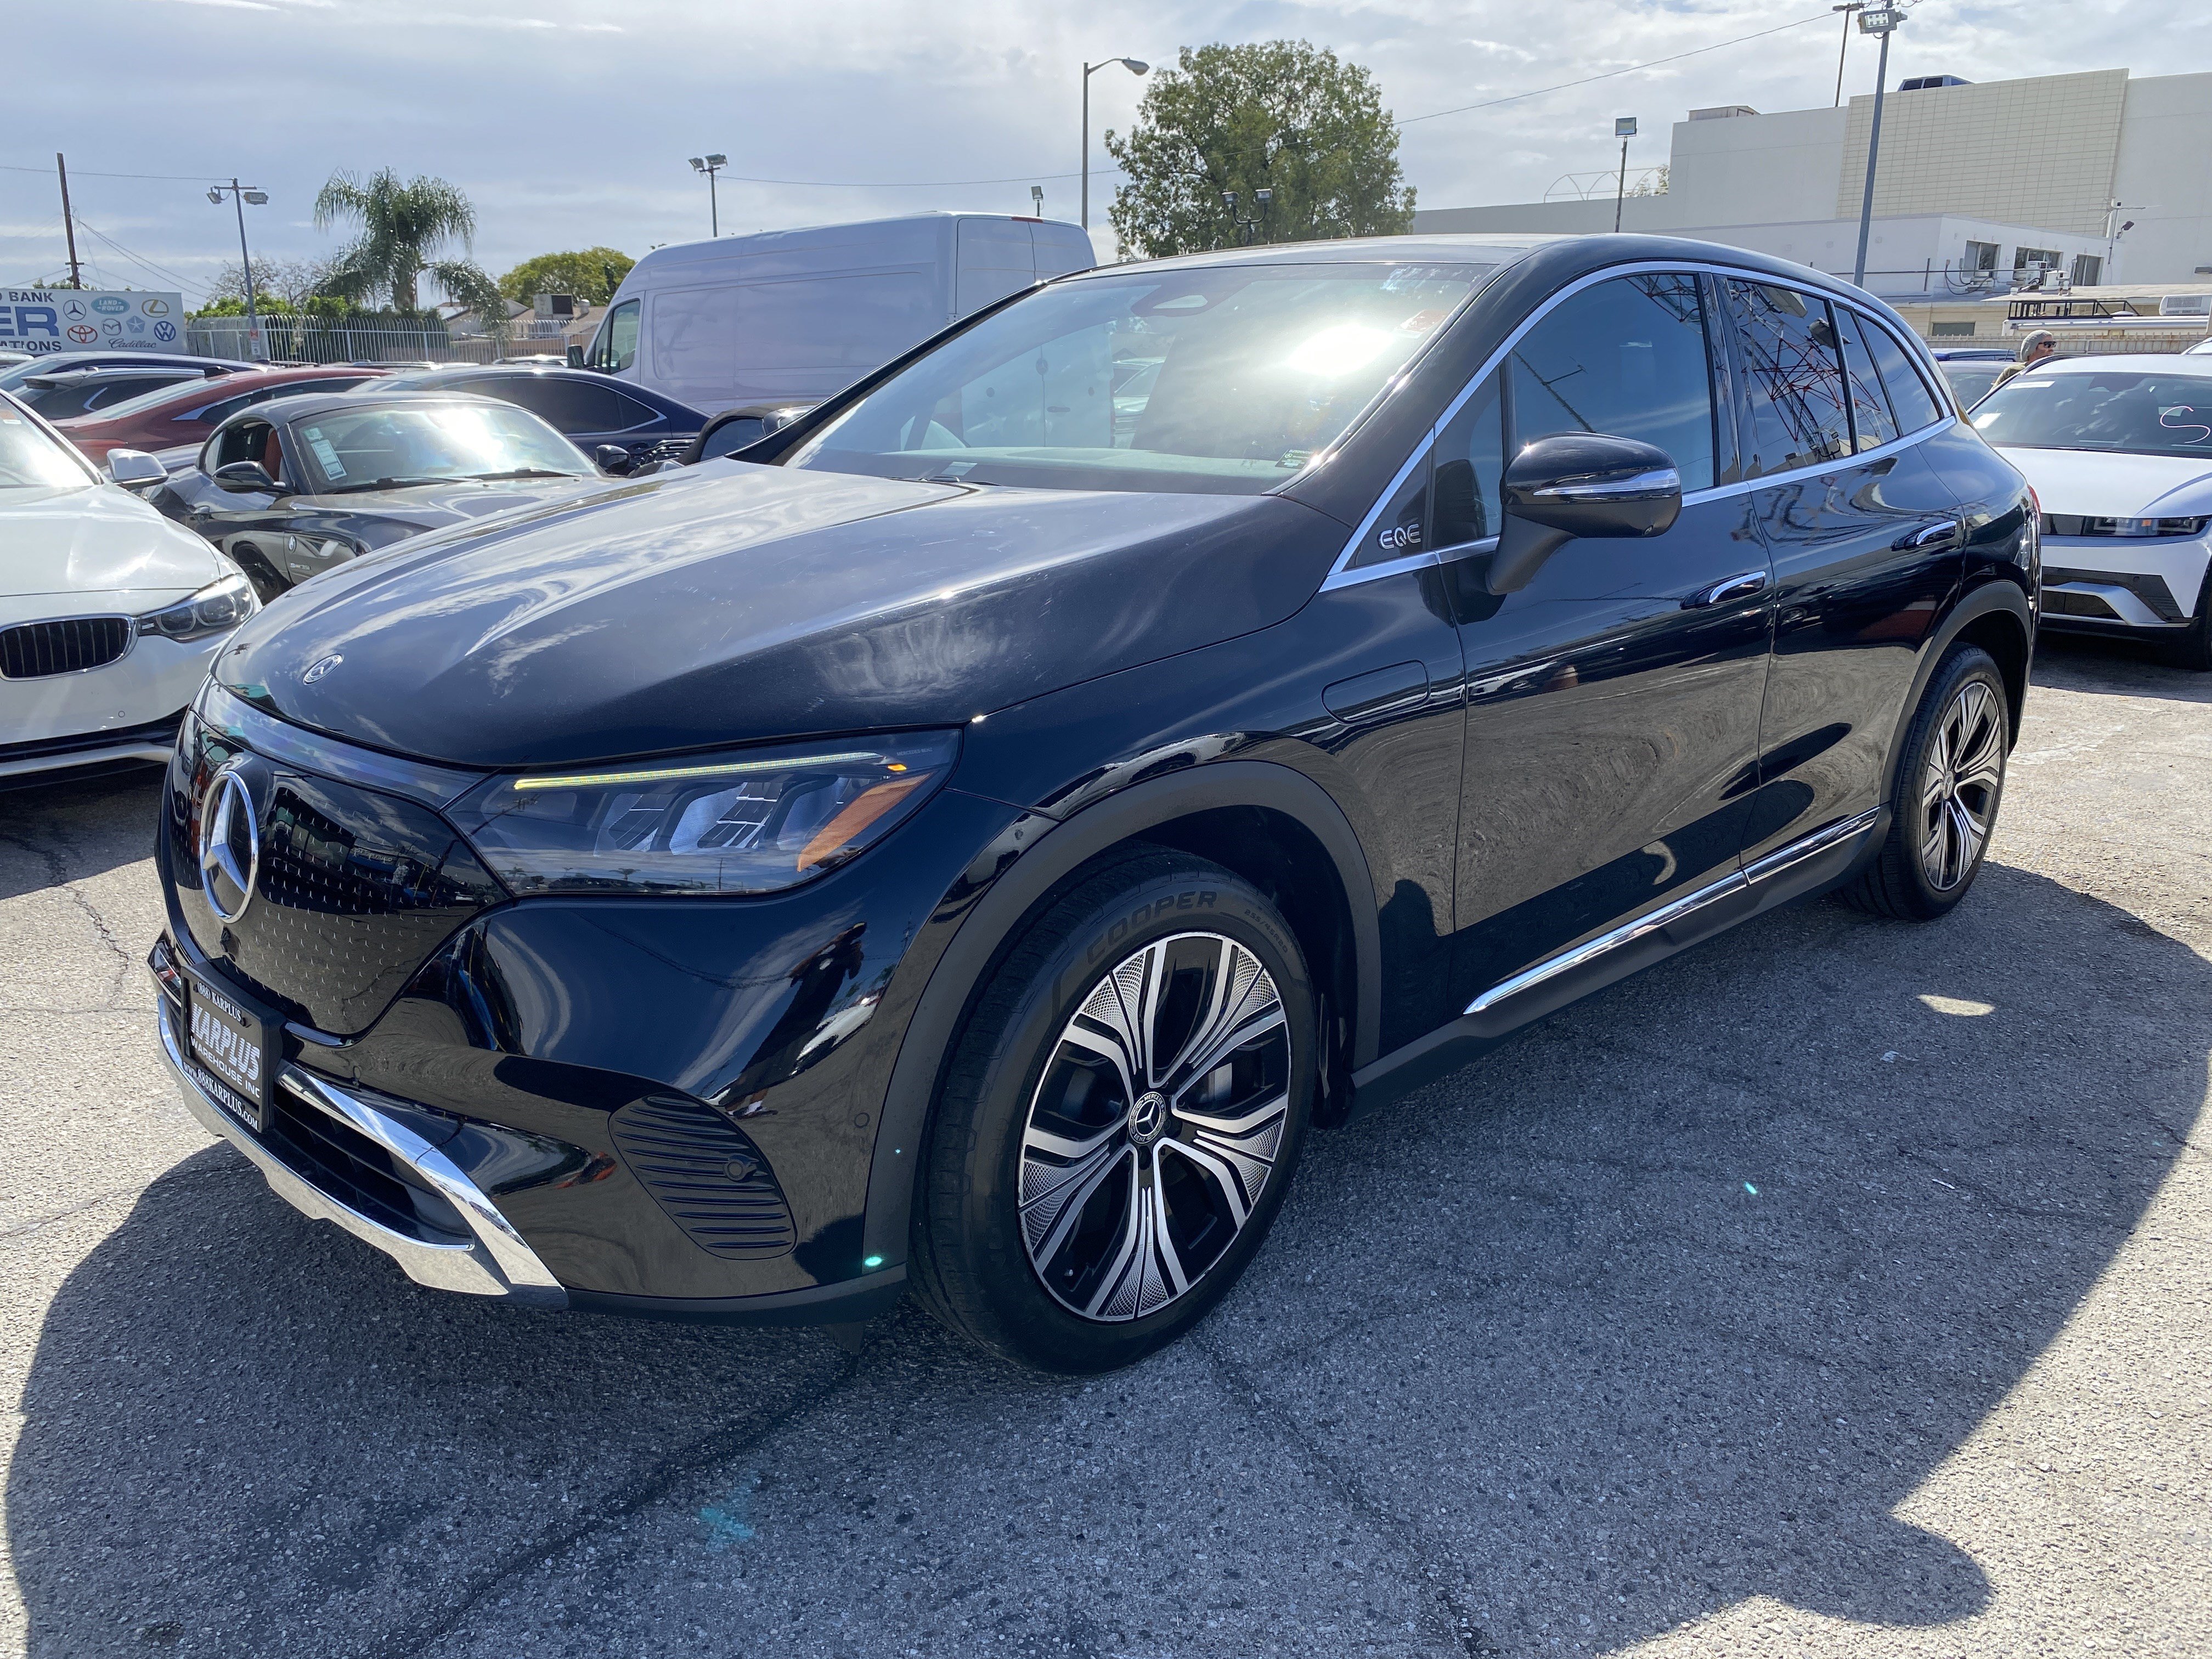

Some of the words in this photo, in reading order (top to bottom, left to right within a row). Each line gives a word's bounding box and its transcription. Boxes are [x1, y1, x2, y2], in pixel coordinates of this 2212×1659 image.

[9, 291, 54, 302] BANK
[109, 338, 156, 348] Cadillac
[1379, 523, 1421, 550] EQE
[1086, 891, 1217, 965] COOPER
[198, 981, 211, 1000] (888)
[211, 991, 241, 1022] KARPLUS
[191, 1002, 261, 1081] KARPLUS
[190, 1035, 242, 1086] WAREHOUSE
[245, 1080, 260, 1098] INC
